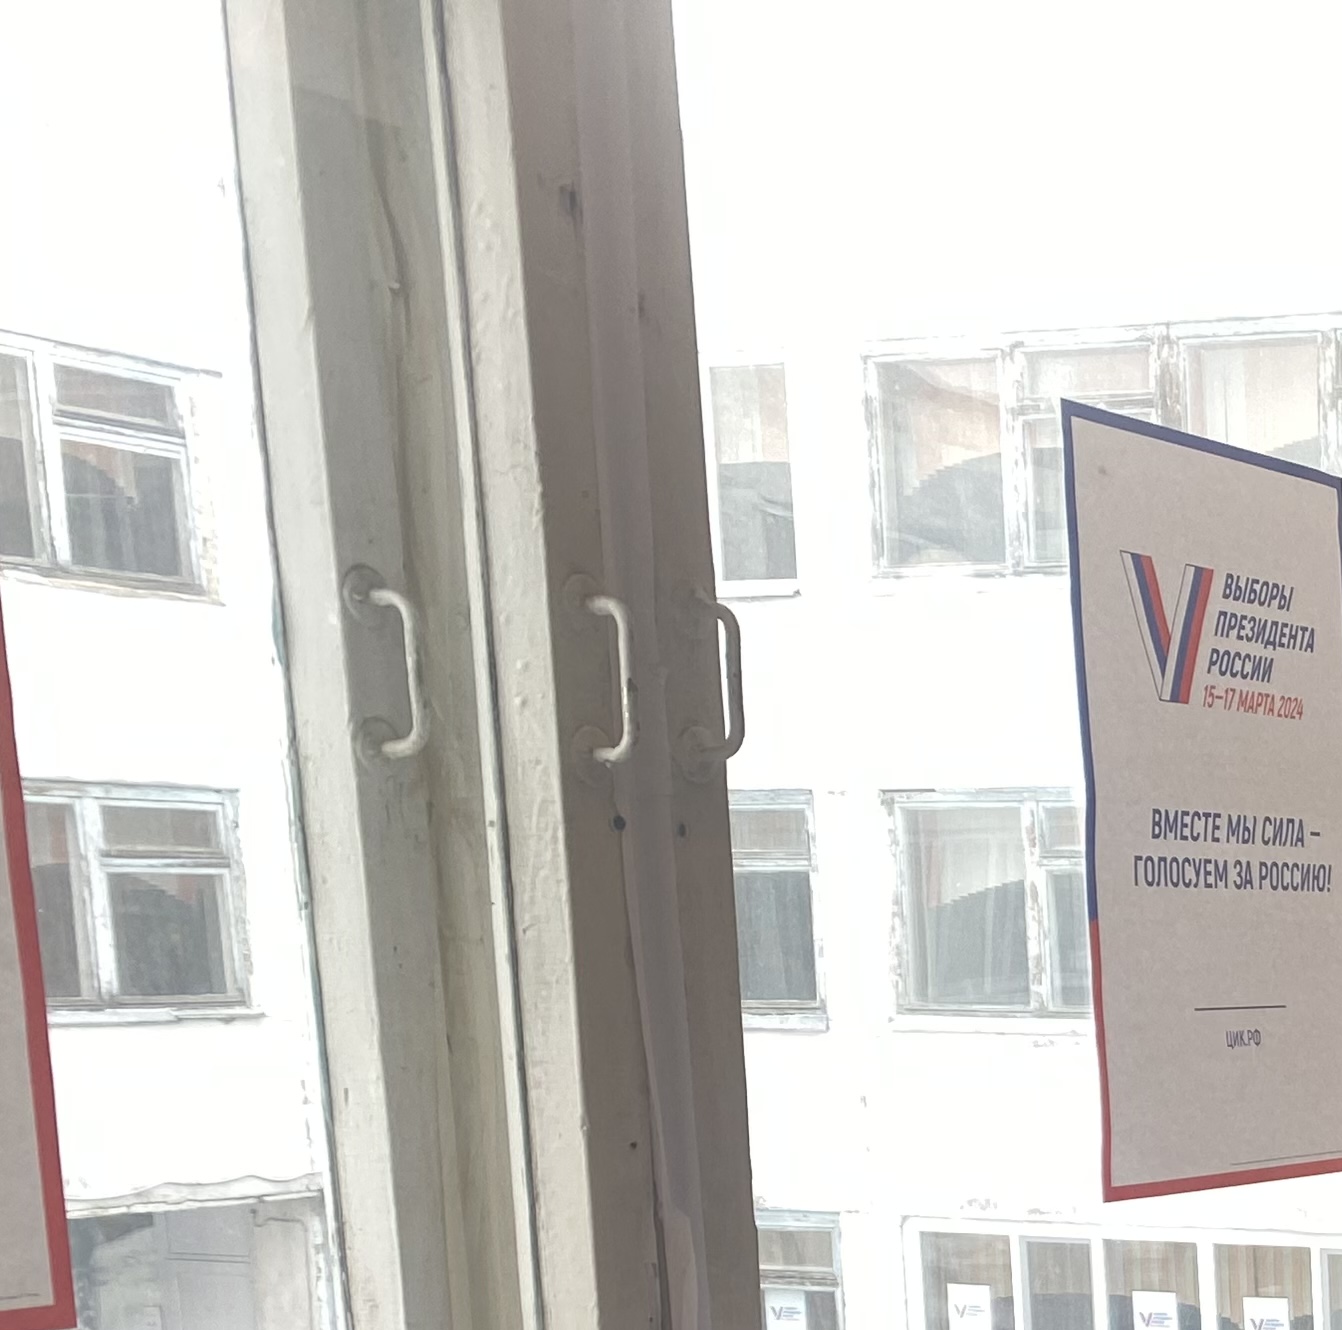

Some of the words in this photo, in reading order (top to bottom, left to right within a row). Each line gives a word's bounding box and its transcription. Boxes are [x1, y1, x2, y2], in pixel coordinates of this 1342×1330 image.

[1221, 572, 1295, 613] ВЫБОРЫ
[1213, 609, 1316, 654] ПРЕЗИДЕНТА
[1206, 647, 1275, 684] РОССИИ
[1236, 692, 1276, 717] МАРТА
[1276, 695, 1305, 721] 2024
[1151, 807, 1223, 844] ВМЕСТЕ
[1225, 813, 1258, 846] МЫ
[1260, 815, 1306, 848] СИЛА
[1133, 854, 1229, 890] ГОЛОСУЕМ
[1232, 859, 1255, 891] ЗА
[1258, 860, 1333, 893] РОССИЮ!
